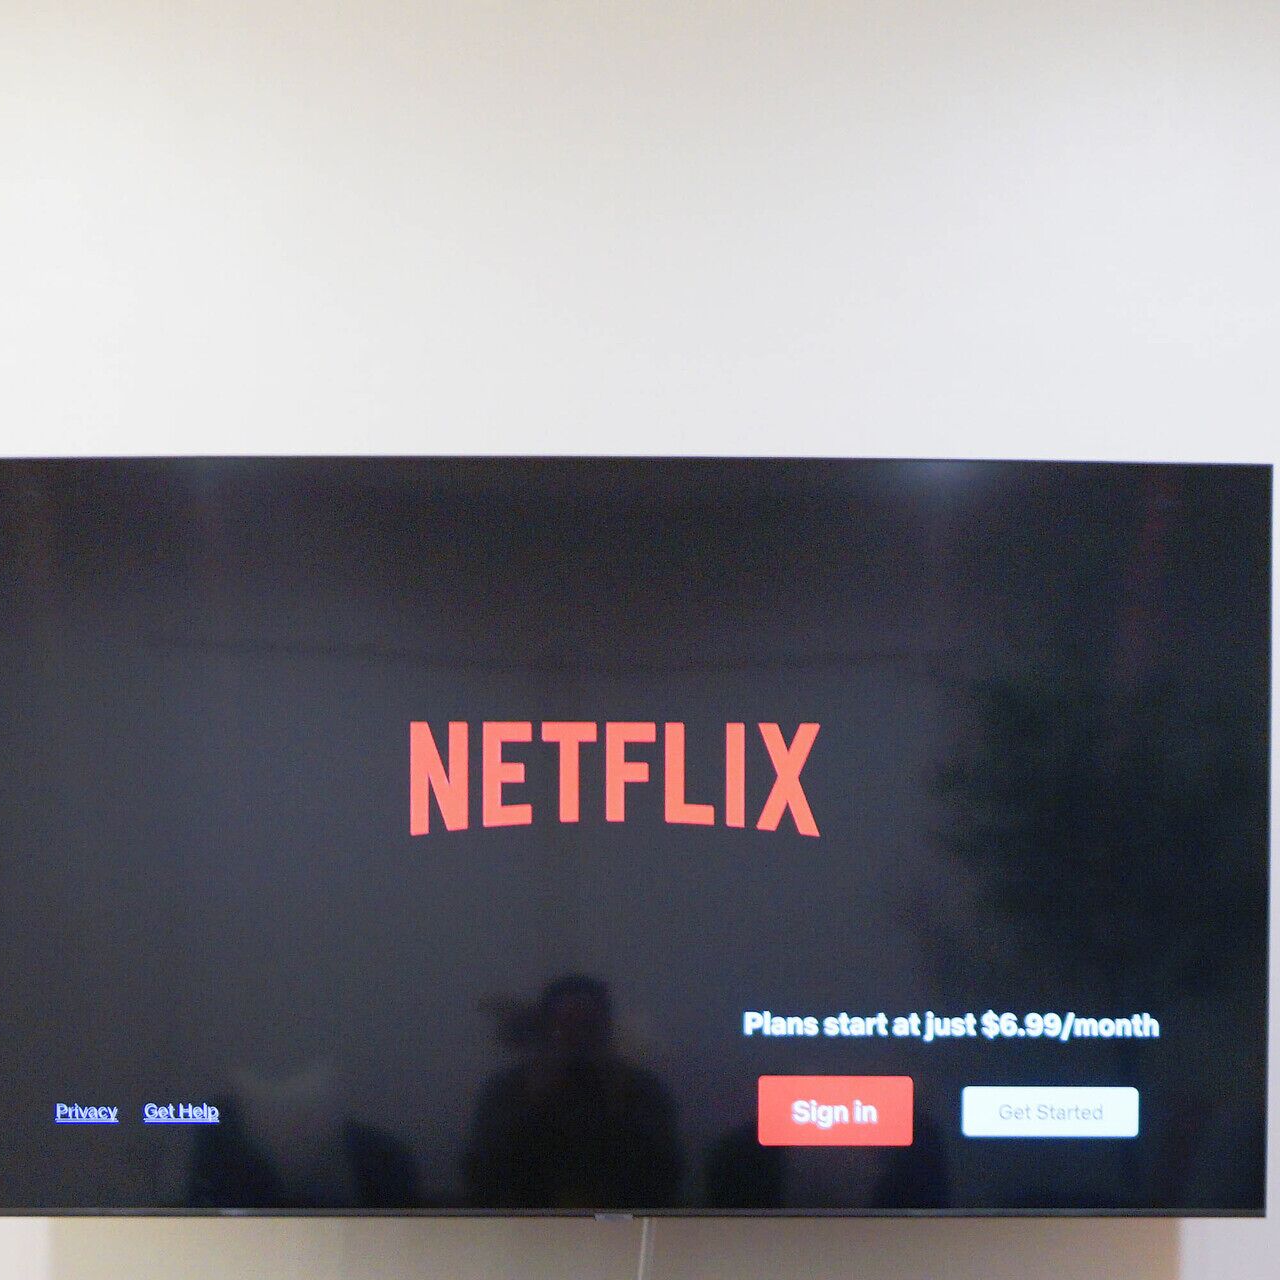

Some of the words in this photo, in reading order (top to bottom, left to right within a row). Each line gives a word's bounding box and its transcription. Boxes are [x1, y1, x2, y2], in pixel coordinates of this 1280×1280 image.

[409, 720, 821, 838] NETFLIX
[742, 1011, 820, 1037] Plans
[823, 1012, 889, 1037] start
[892, 1013, 920, 1037] at
[922, 1012, 977, 1042] just
[980, 1009, 1161, 1043] $6.99/month
[55, 1102, 119, 1123] Privacy
[143, 1102, 176, 1122] Get
[178, 1102, 220, 1123] Help
[791, 1100, 850, 1129] Sign
[853, 1100, 879, 1125] in
[998, 1103, 1032, 1121] Get
[1036, 1103, 1104, 1121] Started
